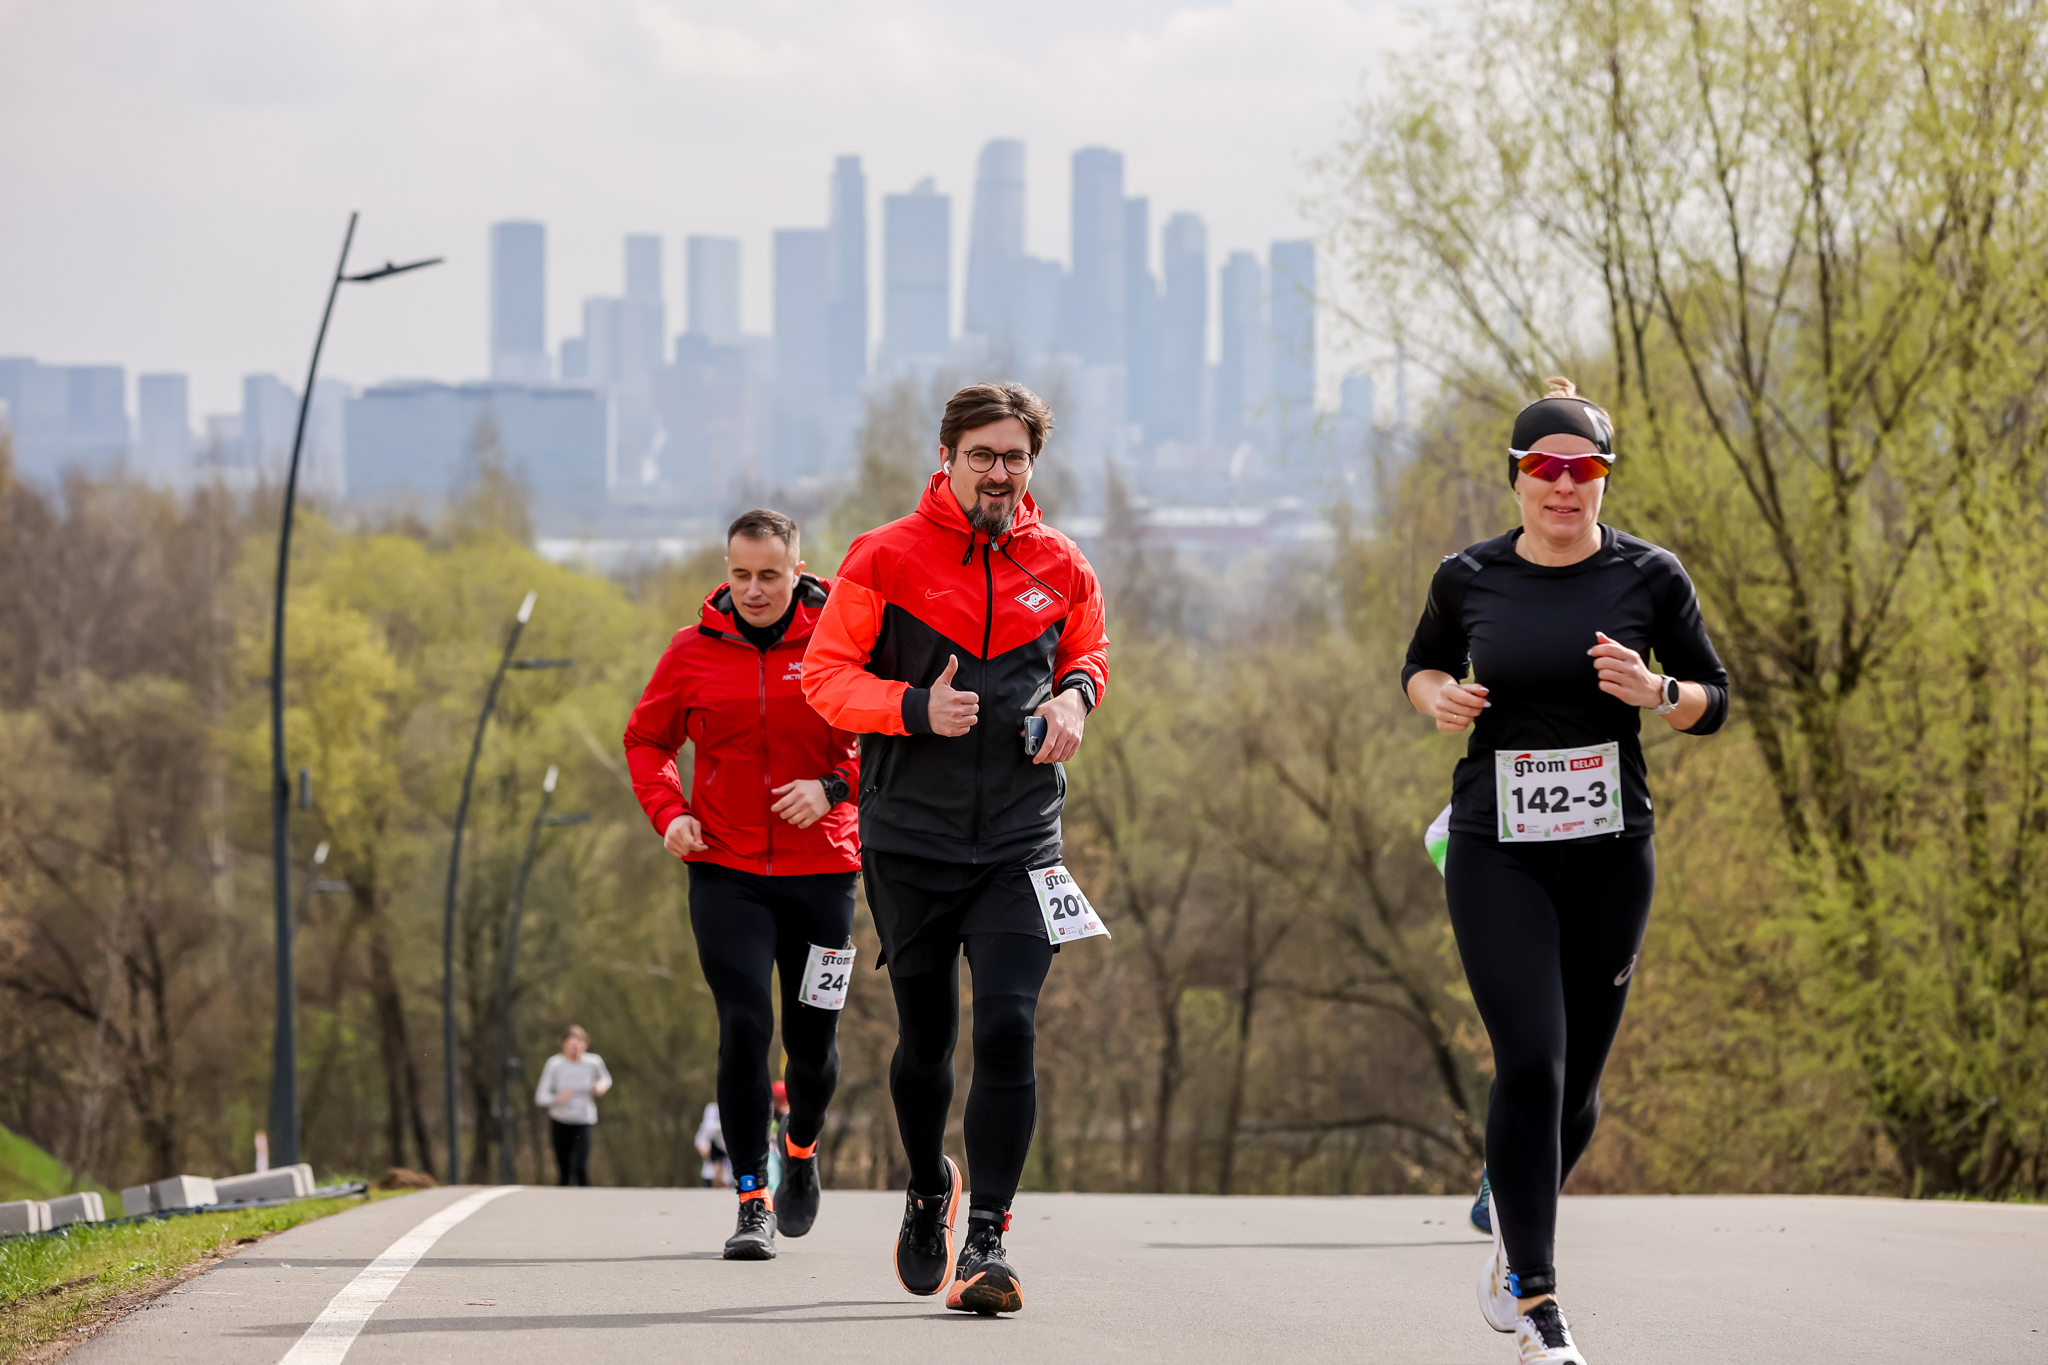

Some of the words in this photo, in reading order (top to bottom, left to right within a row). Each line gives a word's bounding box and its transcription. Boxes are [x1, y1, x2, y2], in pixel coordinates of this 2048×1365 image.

[1514, 761, 1566, 777] grom
[1572, 757, 1601, 770] RELAY
[1512, 781, 1607, 814] 142-3
